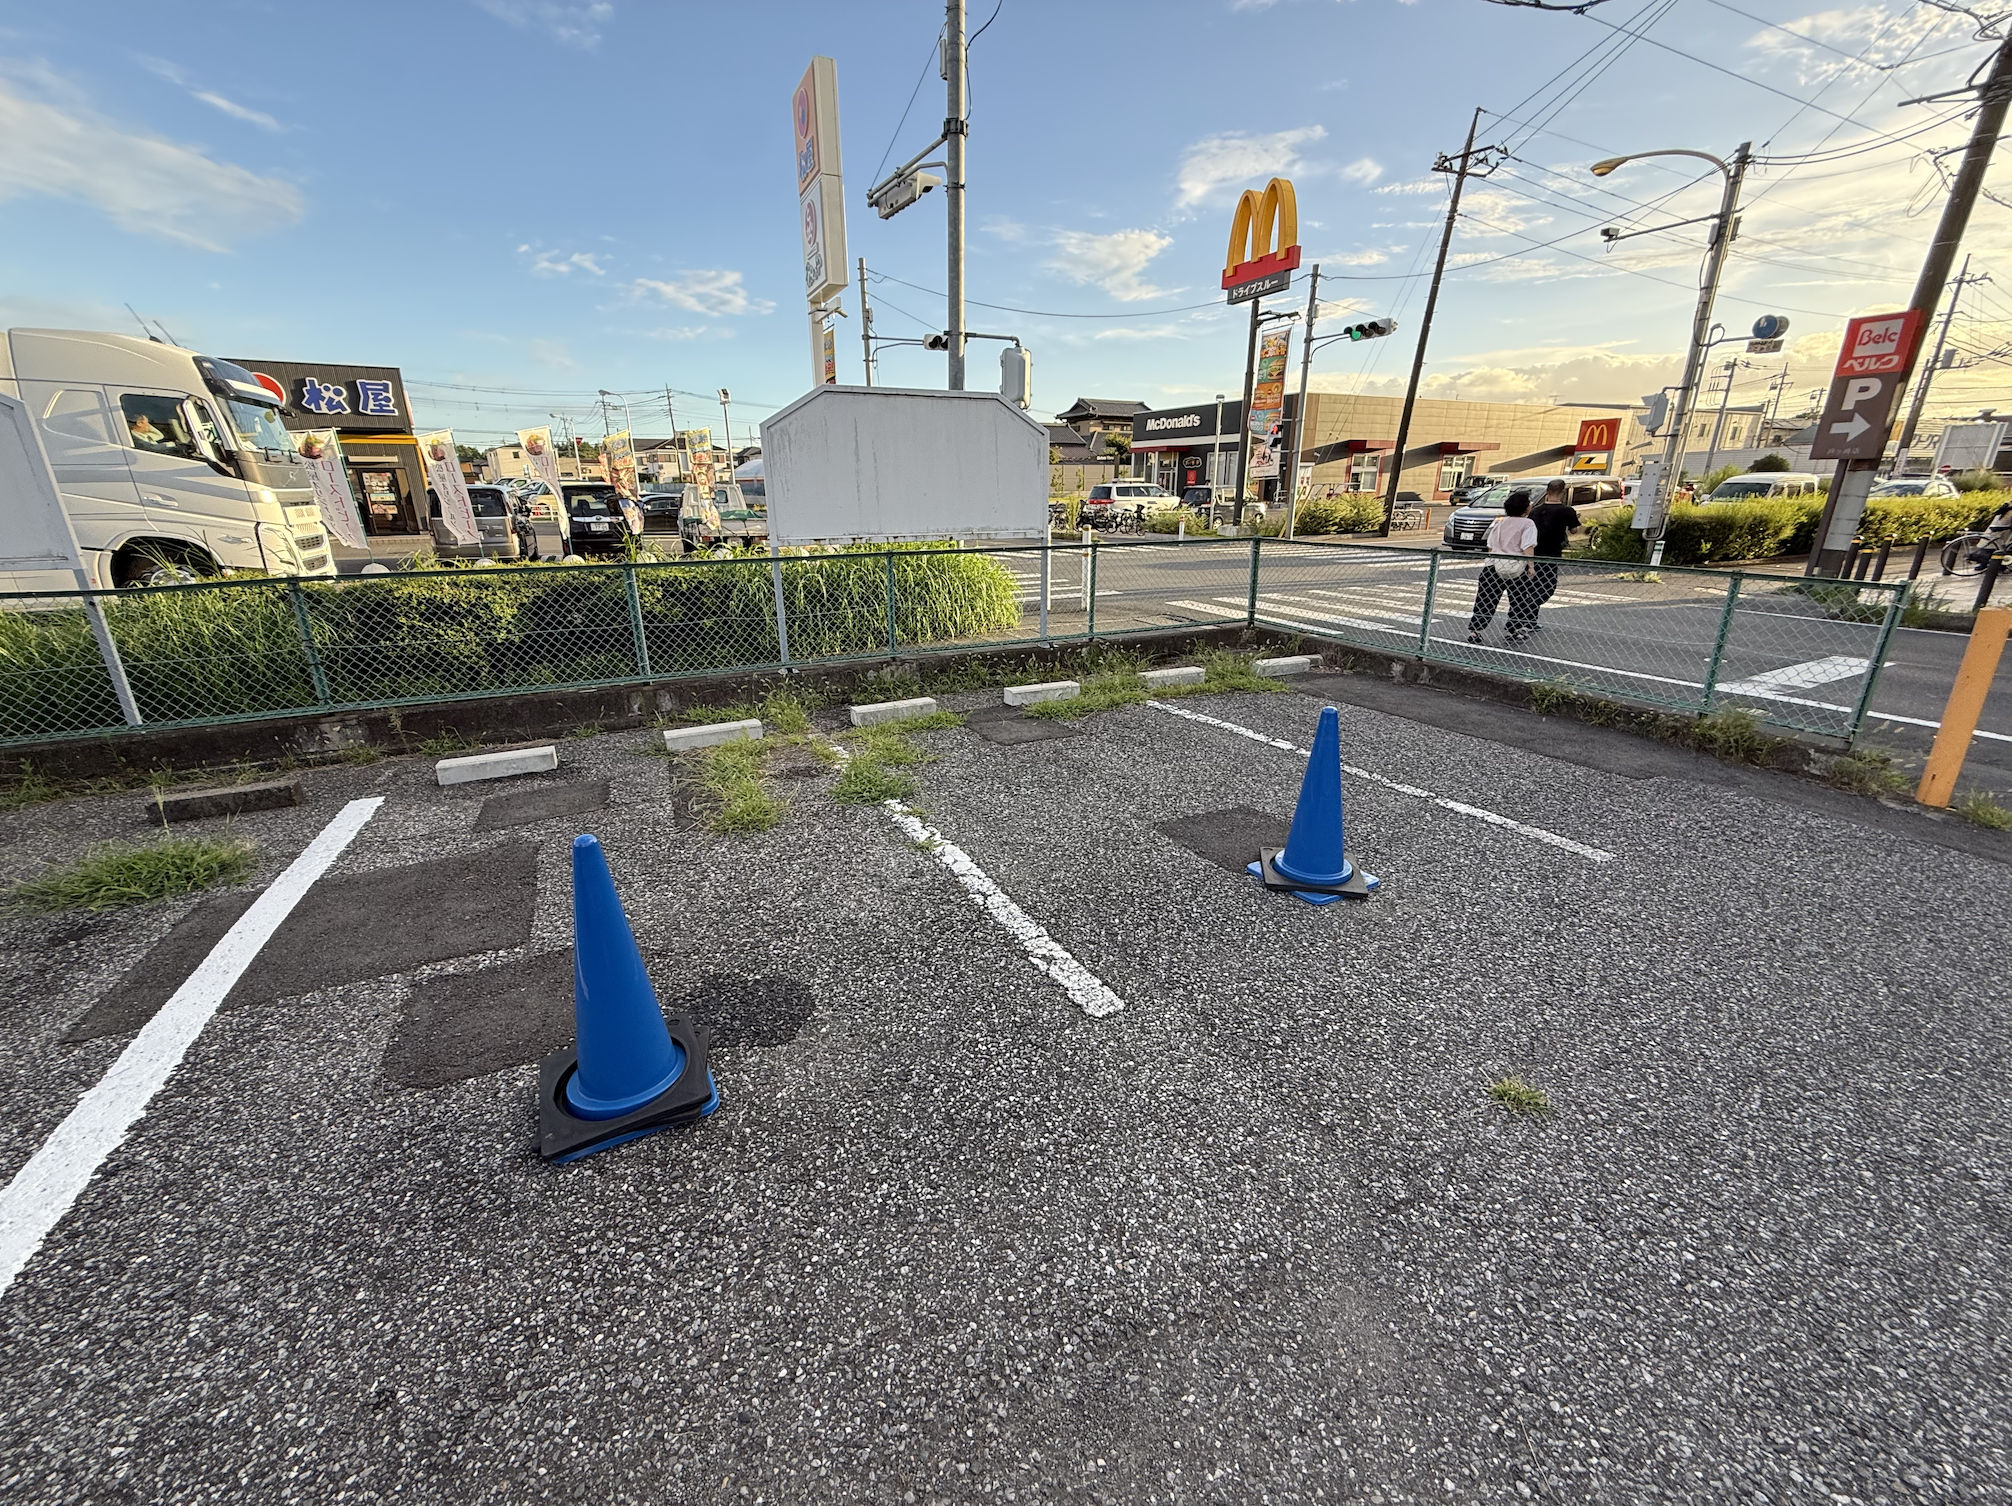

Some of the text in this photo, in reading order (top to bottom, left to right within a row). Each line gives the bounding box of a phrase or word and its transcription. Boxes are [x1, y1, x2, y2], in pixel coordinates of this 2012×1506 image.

[1232, 279, 1278, 299] ドライブスルー
[1858, 327, 1898, 346] Belc
[1842, 355, 1900, 371] ベルク
[302, 377, 398, 416] 松屋
[1841, 377, 1883, 411] P
[1145, 413, 1201, 431] McDonald's
